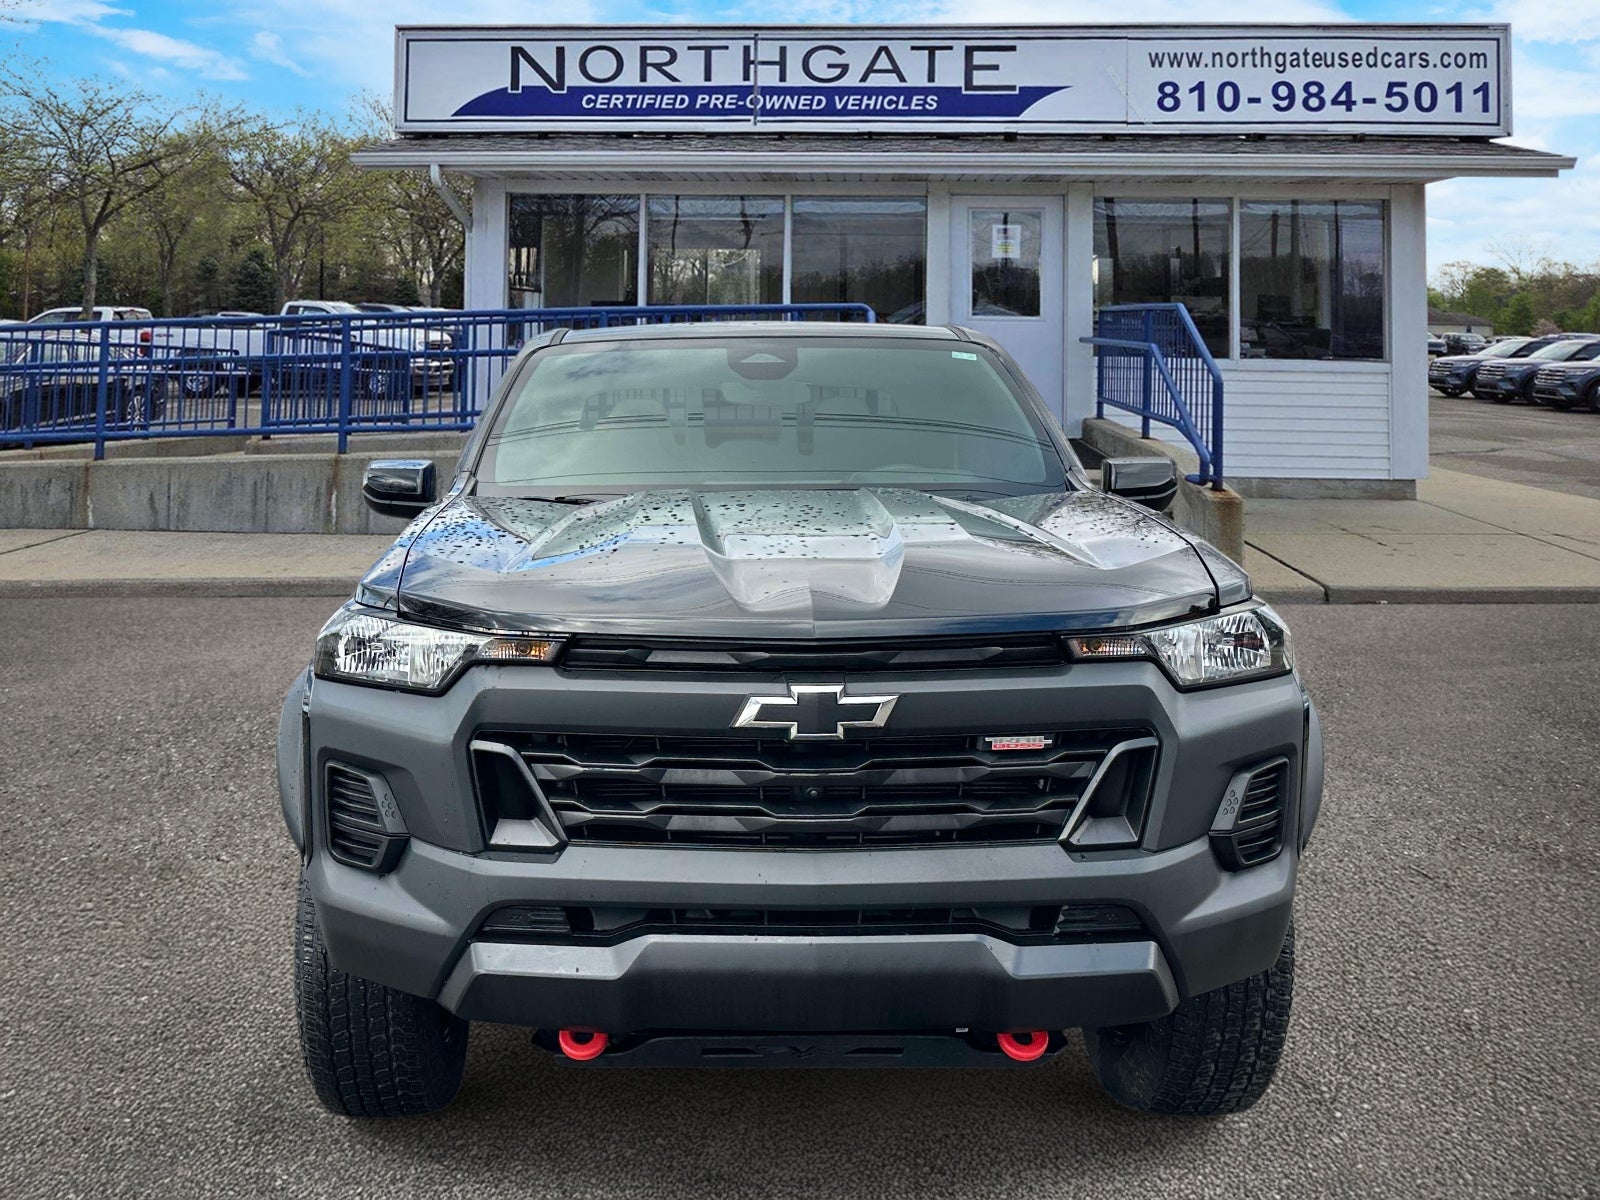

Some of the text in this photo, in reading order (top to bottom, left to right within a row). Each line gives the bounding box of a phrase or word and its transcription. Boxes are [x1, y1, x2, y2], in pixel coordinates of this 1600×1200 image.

[510, 44, 1017, 92] NORTHGATE
[1148, 46, 1488, 73] www.northgateusedcars.com
[581, 93, 938, 111] CERTIFIED PRE-OWNED VEHICLES
[1156, 80, 1491, 114] 810-984-5011
